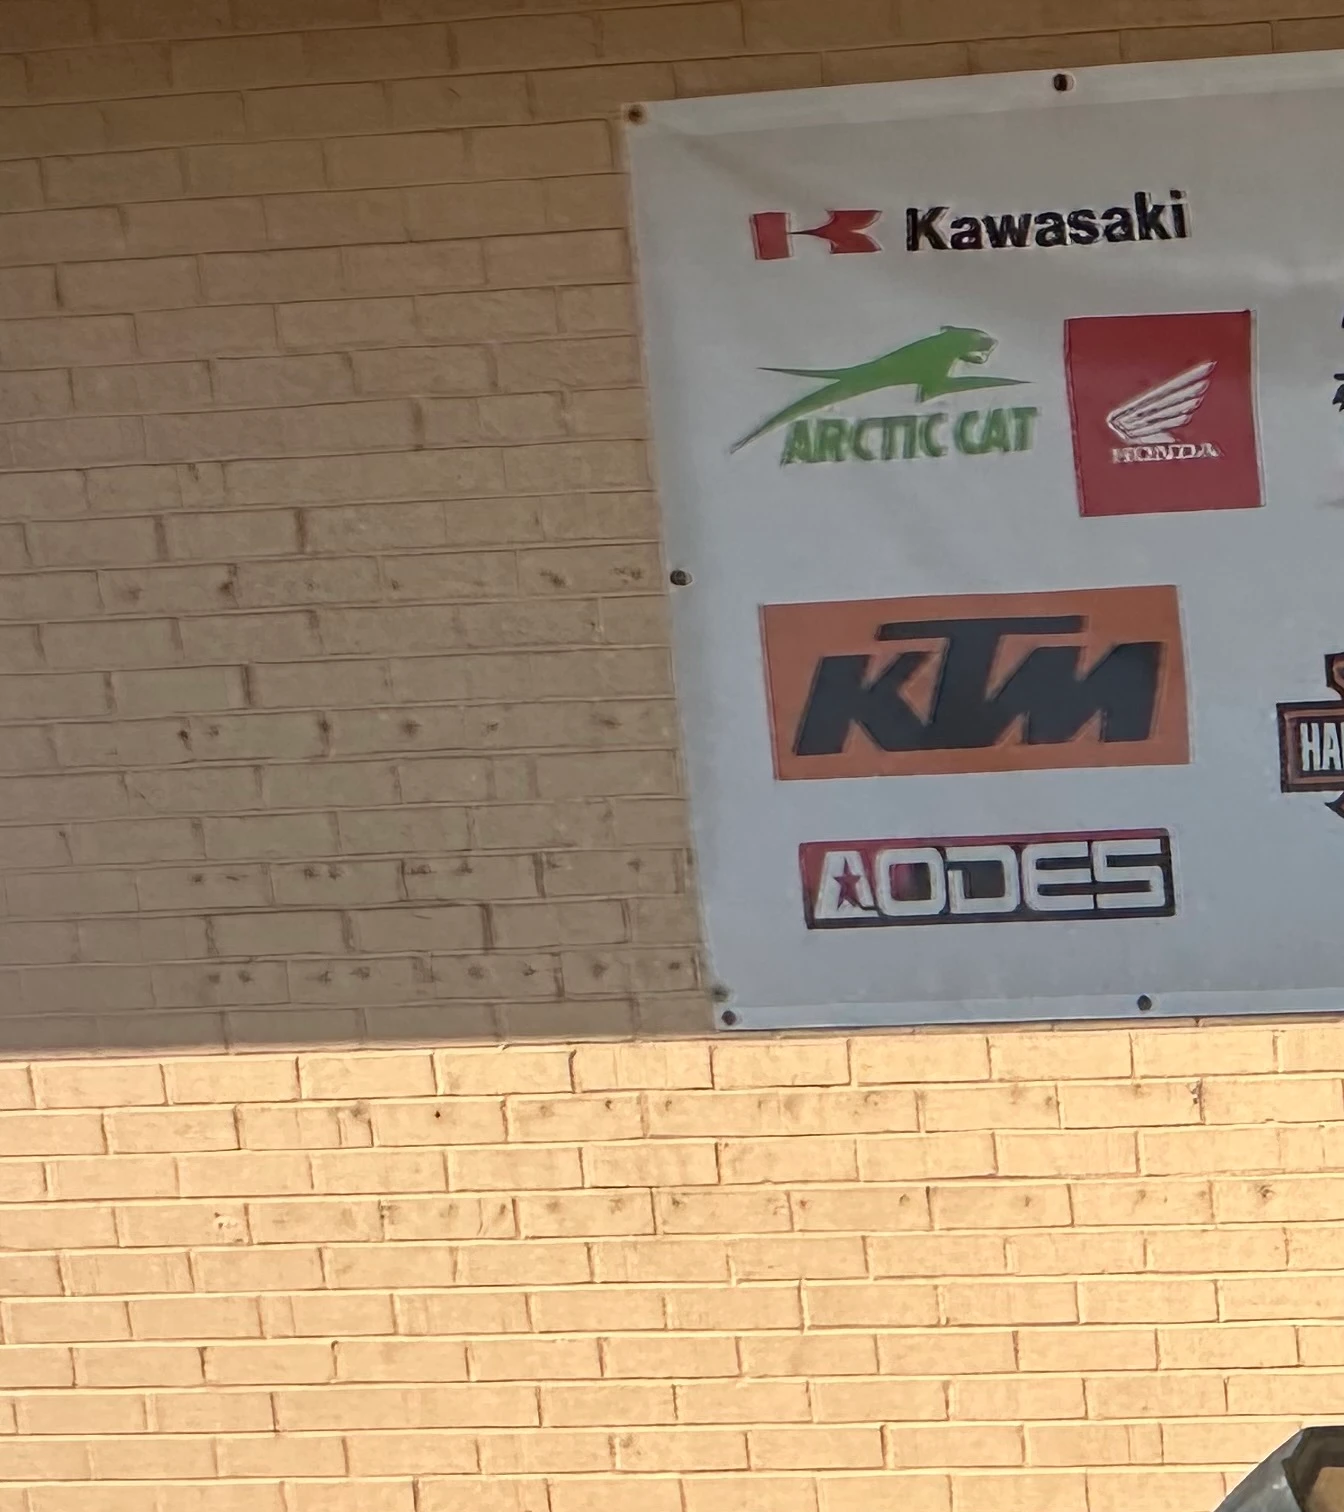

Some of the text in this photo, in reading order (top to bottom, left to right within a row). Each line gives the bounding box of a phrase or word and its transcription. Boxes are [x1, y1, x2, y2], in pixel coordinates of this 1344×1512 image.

[906, 191, 1190, 252] Kawasaki
[782, 406, 1040, 464] ARCTIC CAT
[1111, 441, 1221, 464] HONDA
[794, 614, 1169, 755] KTM
[814, 838, 1167, 920] AODES
